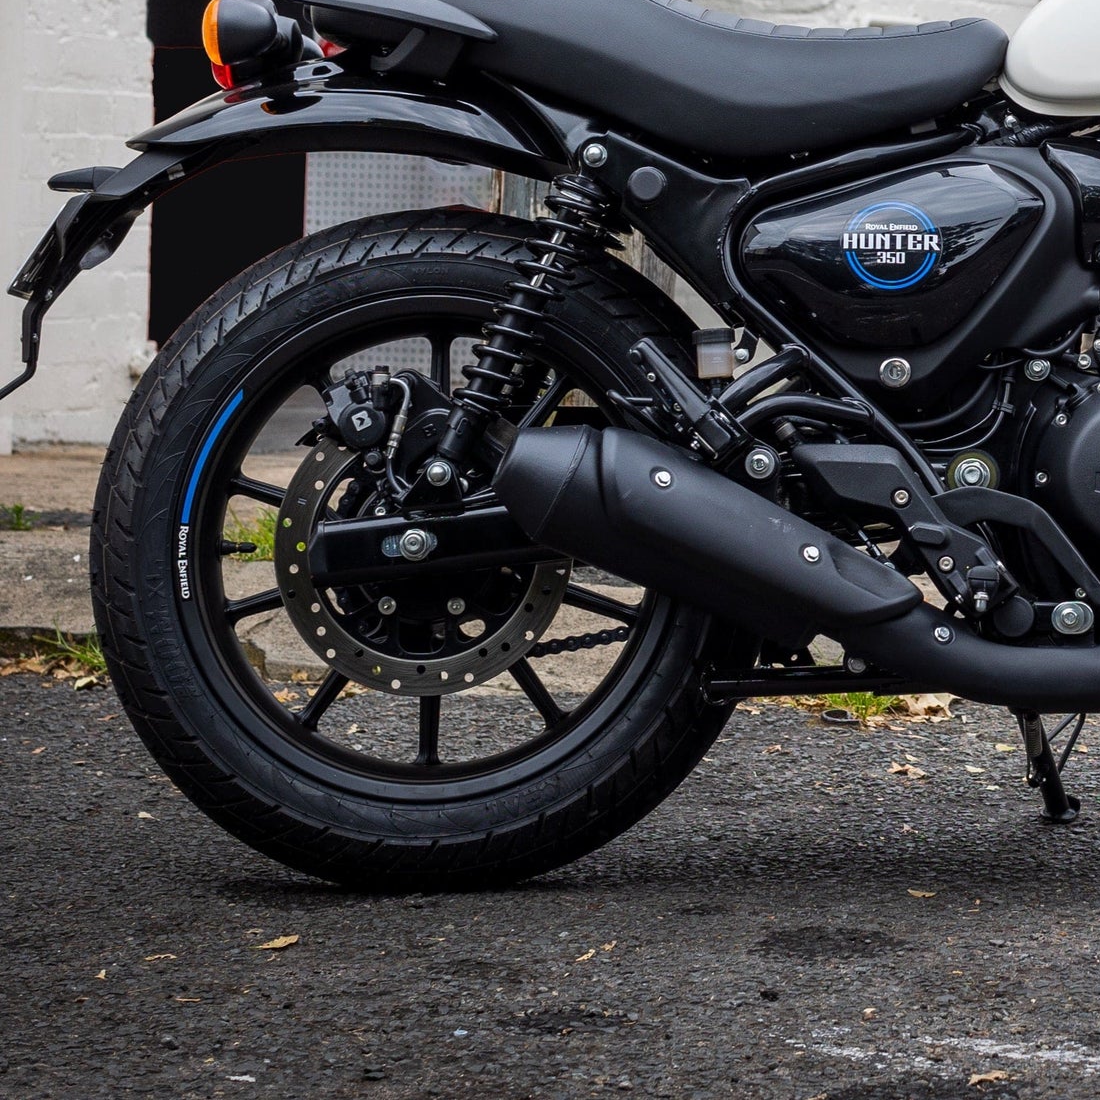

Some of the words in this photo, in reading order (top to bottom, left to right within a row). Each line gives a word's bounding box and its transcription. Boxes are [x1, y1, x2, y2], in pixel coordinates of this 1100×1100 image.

[865, 223, 888, 231] ROYAL
[889, 223, 918, 231] ENFIELD
[843, 233, 940, 251] HUNTER
[876, 251, 906, 264] 350
[178, 525, 190, 558] ROYAL
[177, 559, 191, 599] ENFIELD
